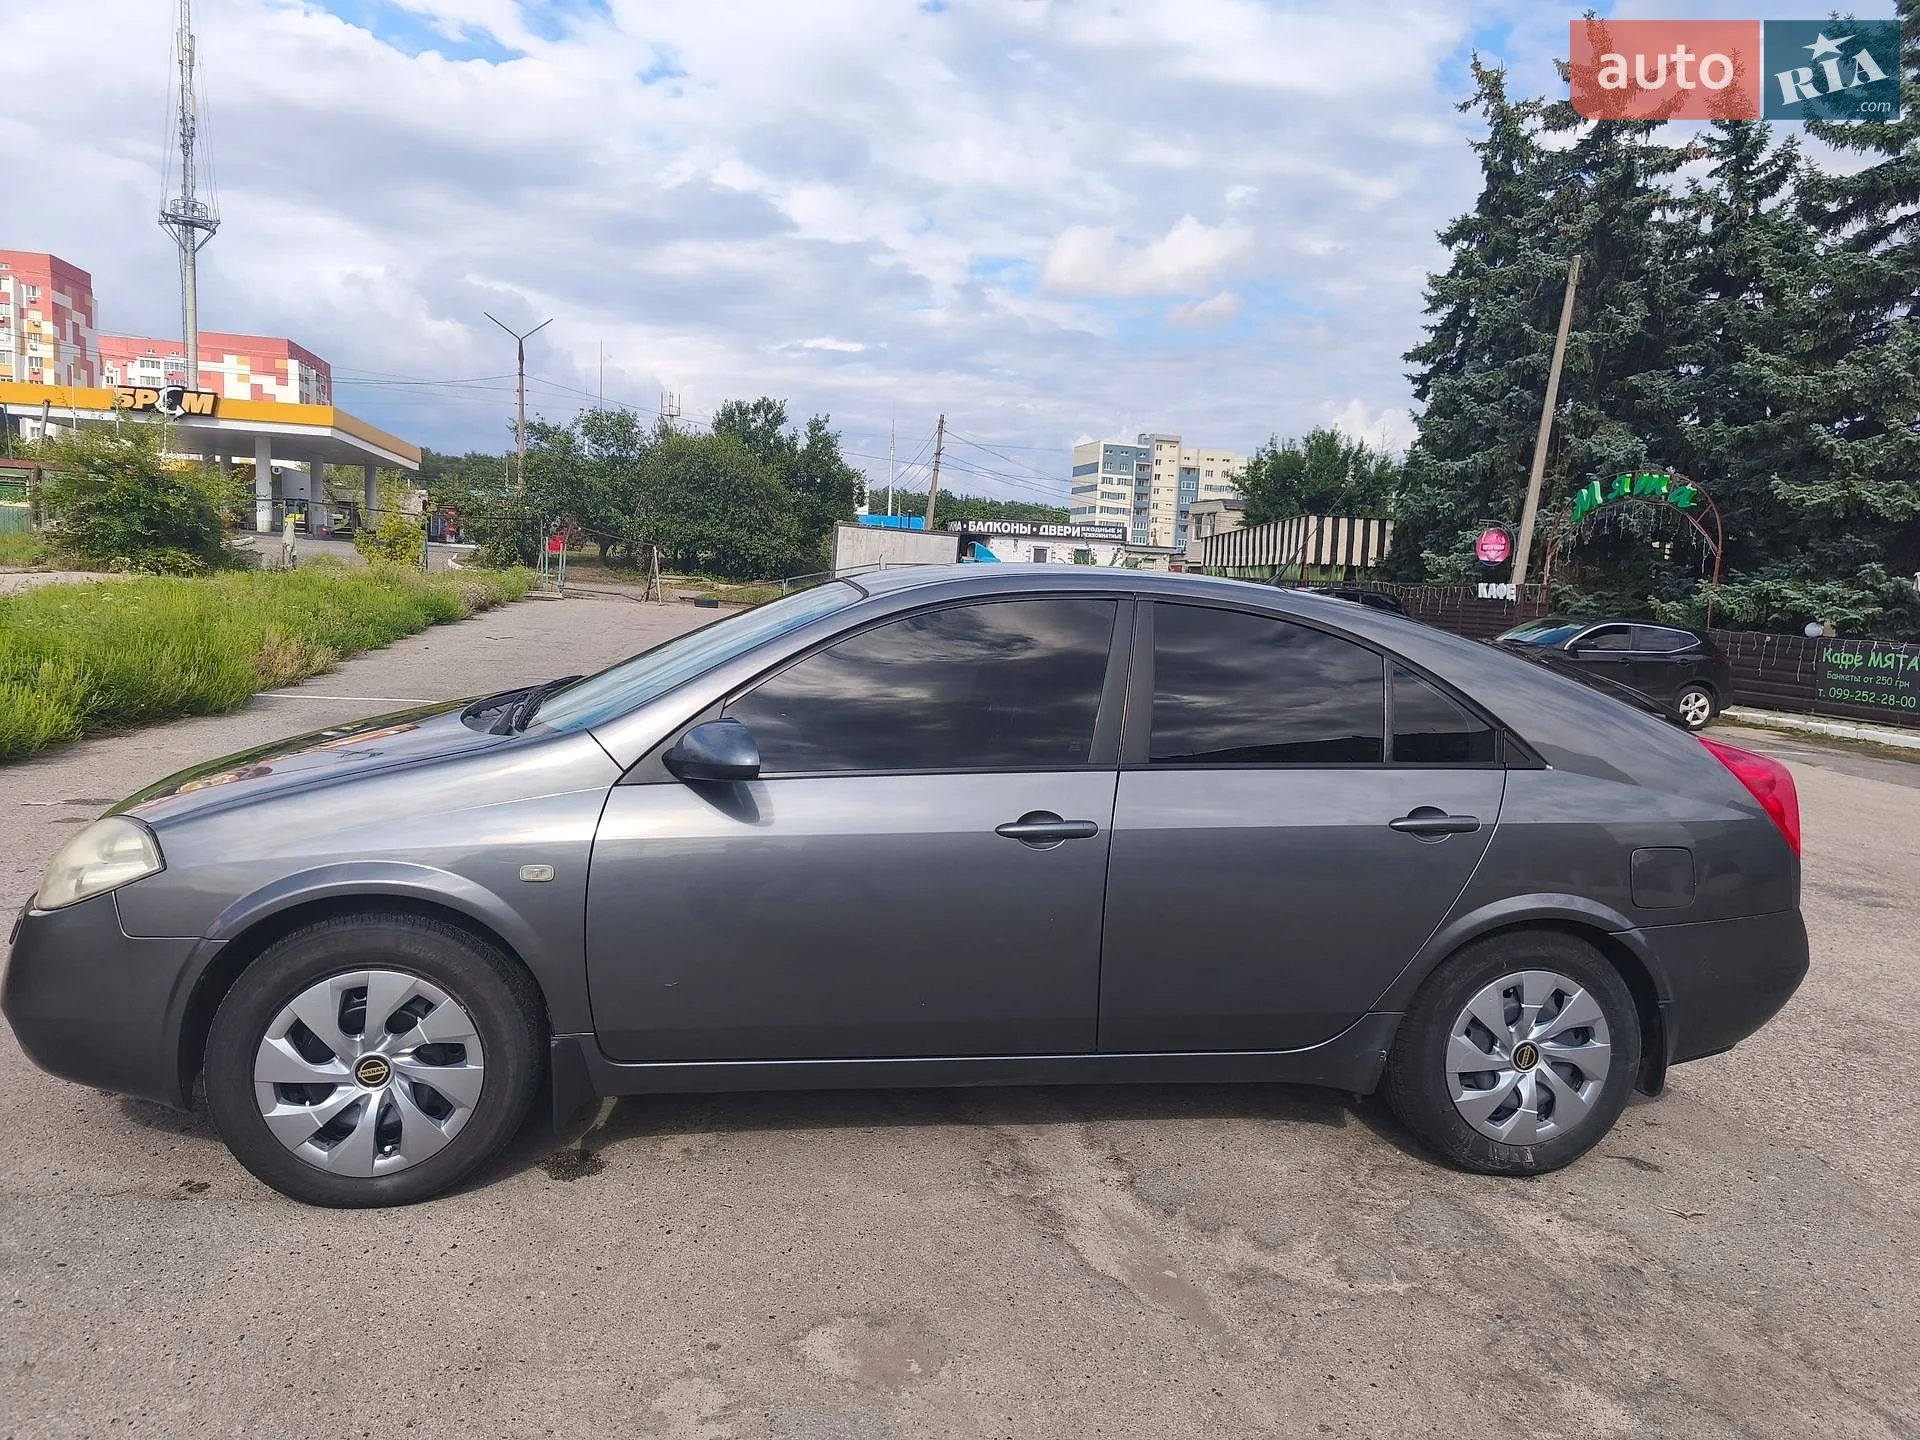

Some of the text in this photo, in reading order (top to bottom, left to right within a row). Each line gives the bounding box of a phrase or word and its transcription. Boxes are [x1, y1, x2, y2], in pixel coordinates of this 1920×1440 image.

[968, 520, 1031, 534] БАЛКОНЫ
[1039, 524, 1081, 537] ДВЕРИ
[1478, 583, 1516, 601] КАФЕ
[1822, 647, 1920, 672] Кафе МЯТА
[1826, 670, 1910, 690] Банкеты от 250 грн
[1829, 687, 1917, 708] 099-252-28-00
[360, 1067, 386, 1077] NISSAN
